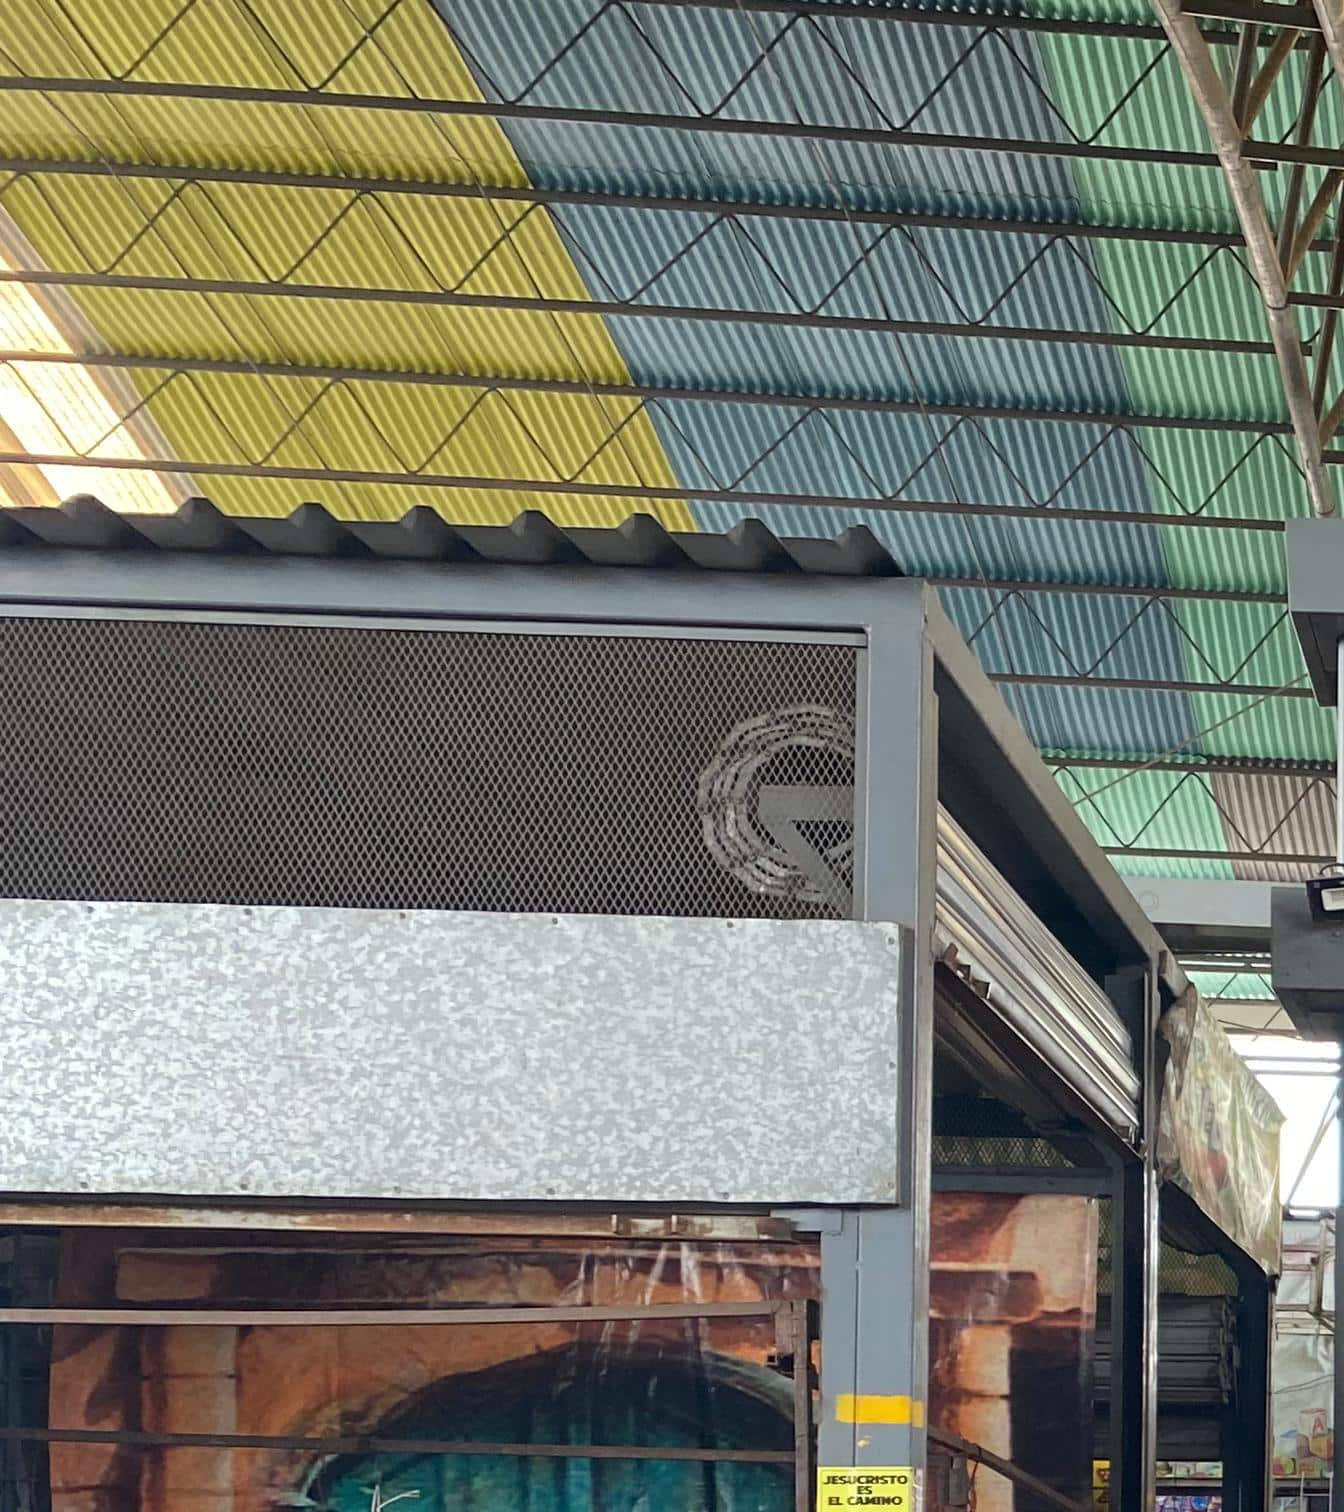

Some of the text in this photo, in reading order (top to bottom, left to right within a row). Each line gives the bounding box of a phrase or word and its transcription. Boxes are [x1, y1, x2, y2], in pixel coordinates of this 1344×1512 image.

[823, 1474, 908, 1485] JESUCRISTO
[857, 1485, 872, 1495] ES
[828, 1495, 903, 1506] EL CAMINO
